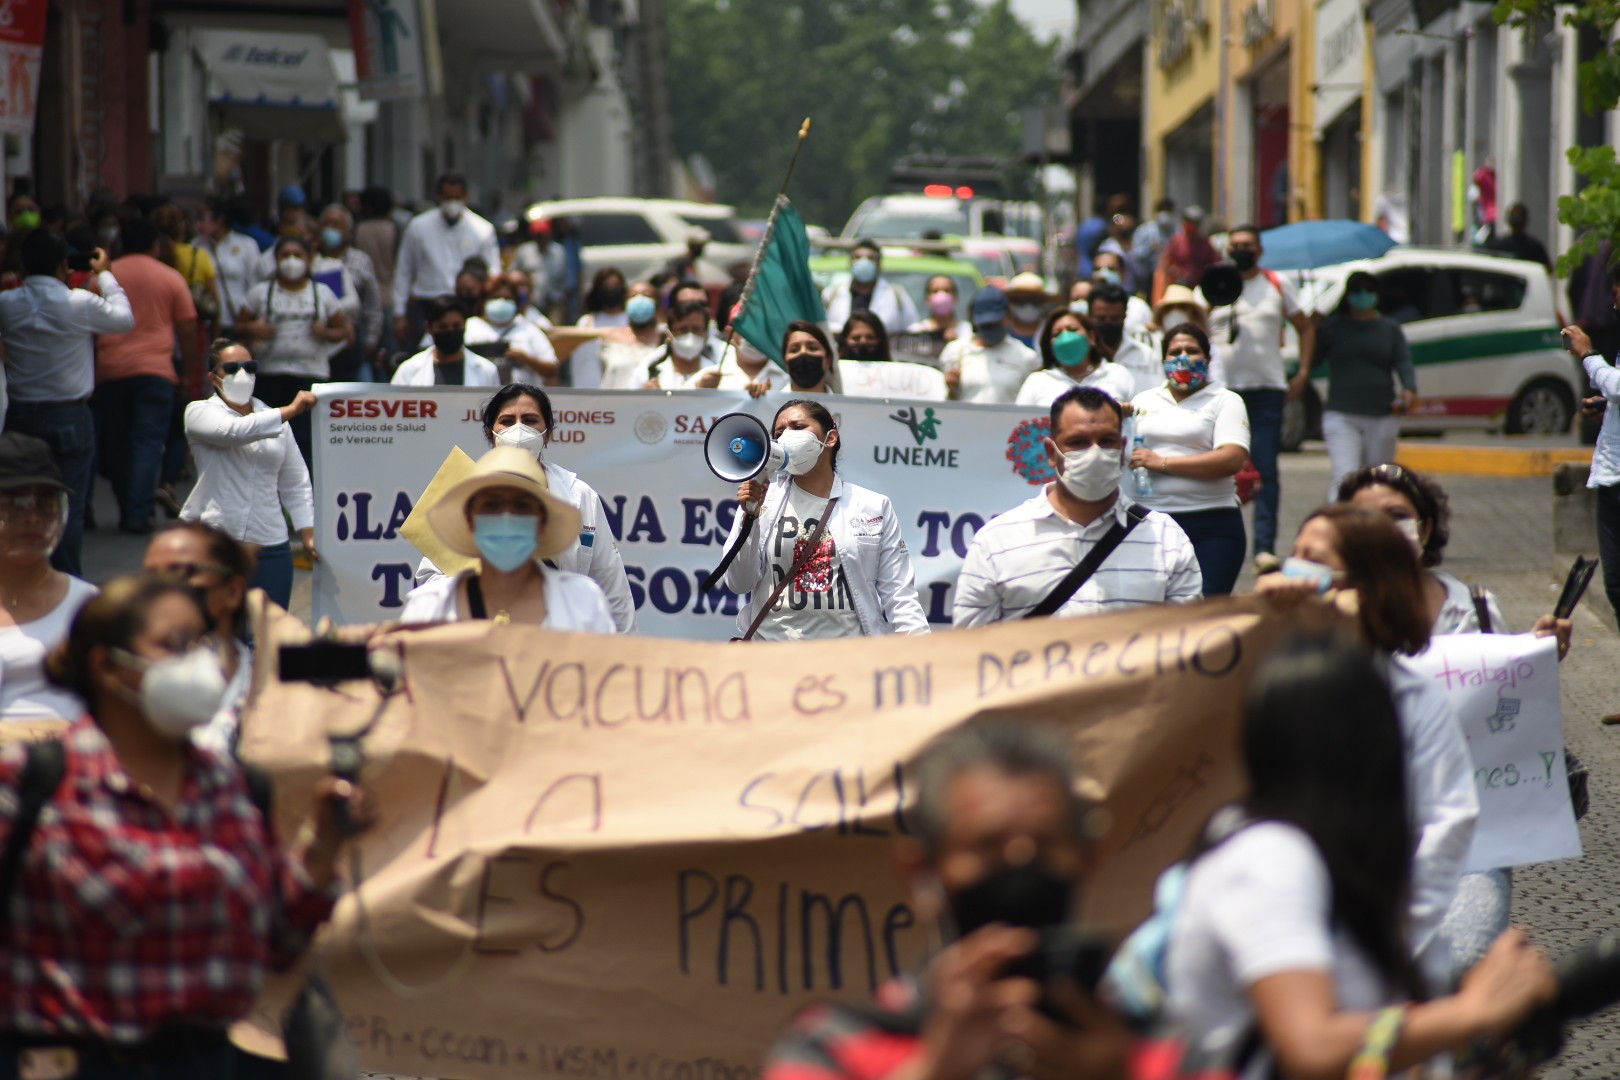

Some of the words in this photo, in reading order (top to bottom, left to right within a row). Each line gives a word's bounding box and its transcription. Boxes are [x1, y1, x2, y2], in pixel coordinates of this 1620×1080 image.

[856, 366, 931, 396] SALUD
[329, 398, 438, 418] SESVER
[330, 422, 377, 432] Servicios
[380, 423, 393, 432] de
[396, 423, 426, 432] Salud
[330, 435, 343, 444] de
[346, 435, 394, 444] Veracruz
[873, 445, 960, 468] UNEME
[337, 491, 413, 541] ¡LA
[624, 565, 752, 616] SOM
[1435, 653, 1534, 697] trabajo
[473, 855, 584, 955] ES
